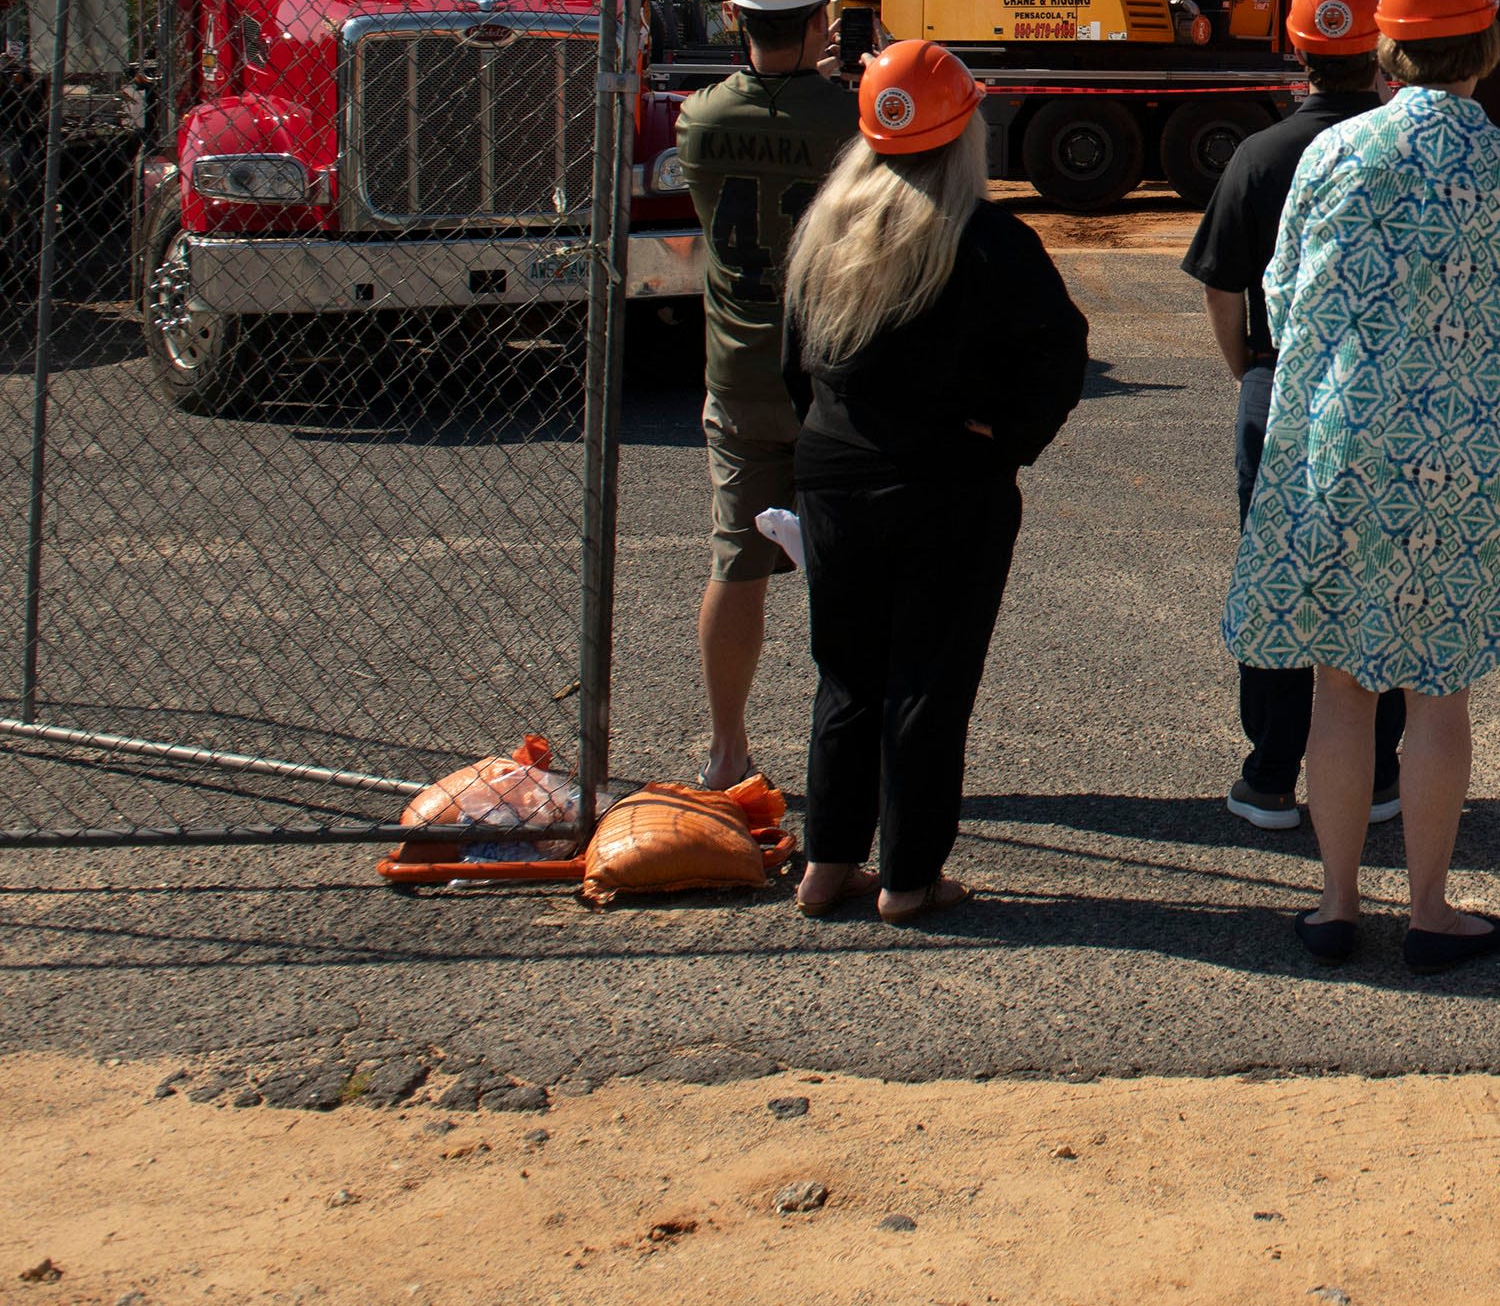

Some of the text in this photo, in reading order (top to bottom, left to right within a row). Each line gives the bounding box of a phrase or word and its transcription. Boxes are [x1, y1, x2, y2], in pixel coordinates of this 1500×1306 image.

[1014, 11, 1077, 22] PENSACOLA, FL
[702, 131, 814, 167] KAMARA
